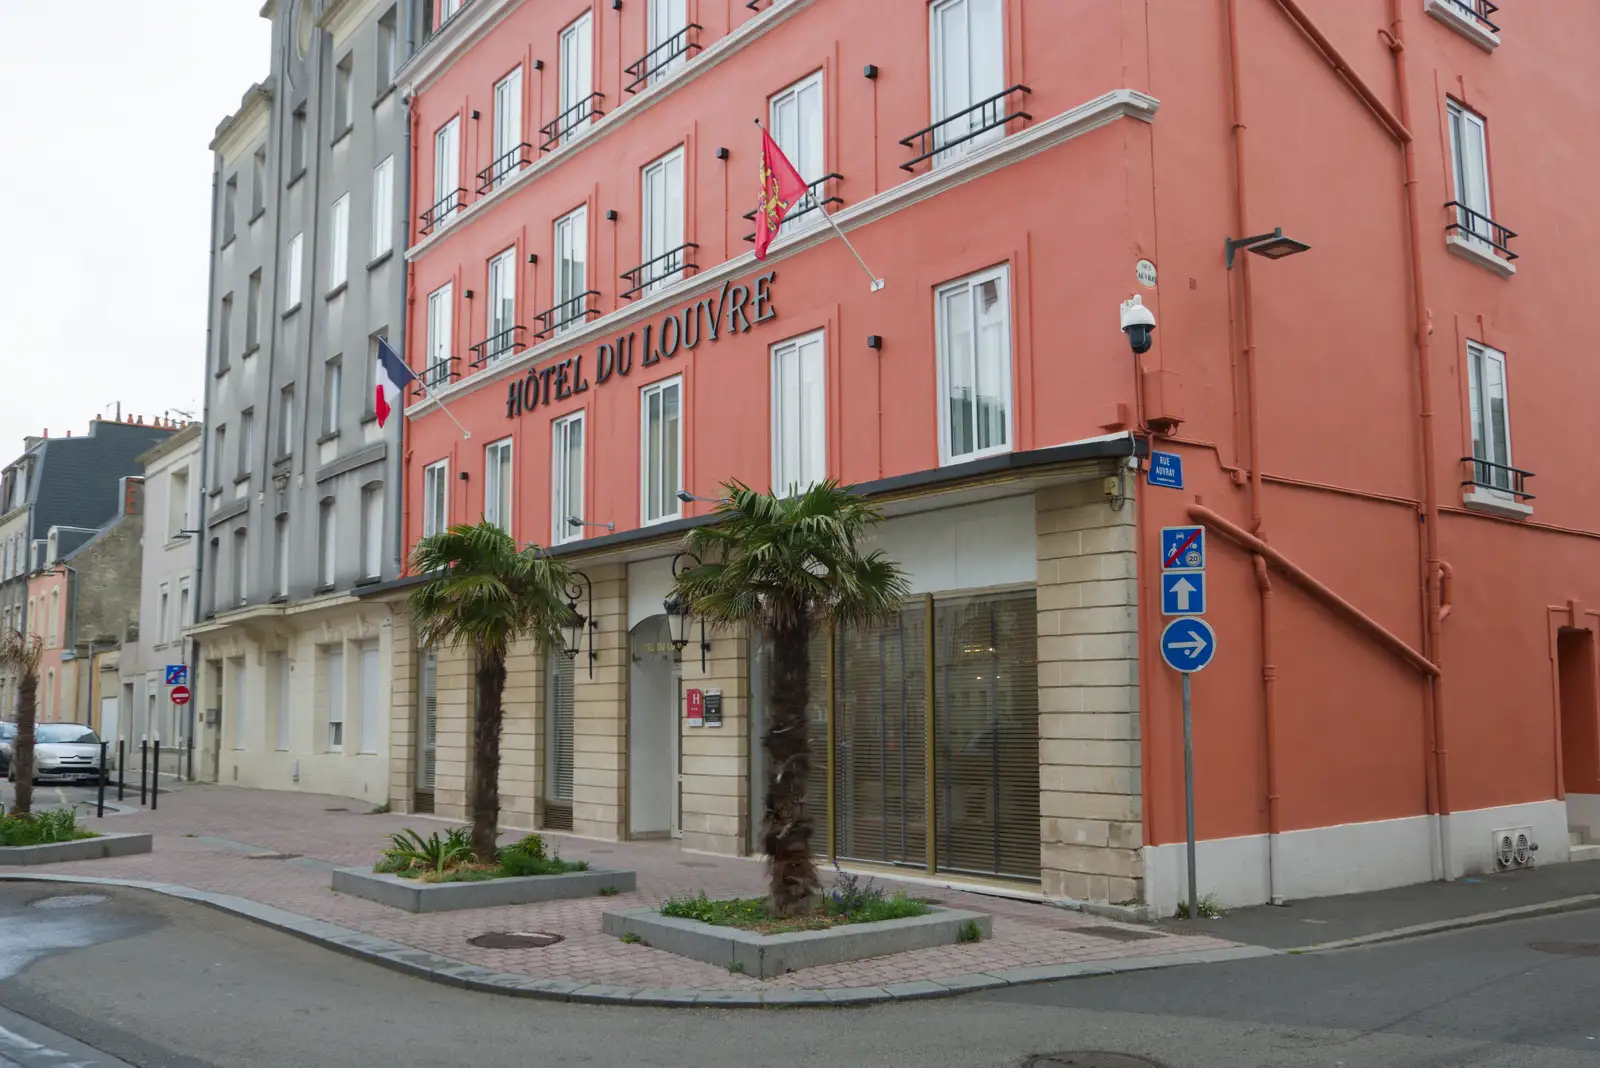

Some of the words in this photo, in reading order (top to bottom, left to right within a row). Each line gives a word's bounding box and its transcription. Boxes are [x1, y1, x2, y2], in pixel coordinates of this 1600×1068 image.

[506, 354, 588, 418] HÔTEL
[595, 332, 636, 385] DU
[641, 271, 777, 367] LOUVRE
[1159, 456, 1170, 466] RUE
[1155, 466, 1176, 477] AUVRAY
[1188, 555, 1199, 563] 20
[692, 693, 700, 705] H
